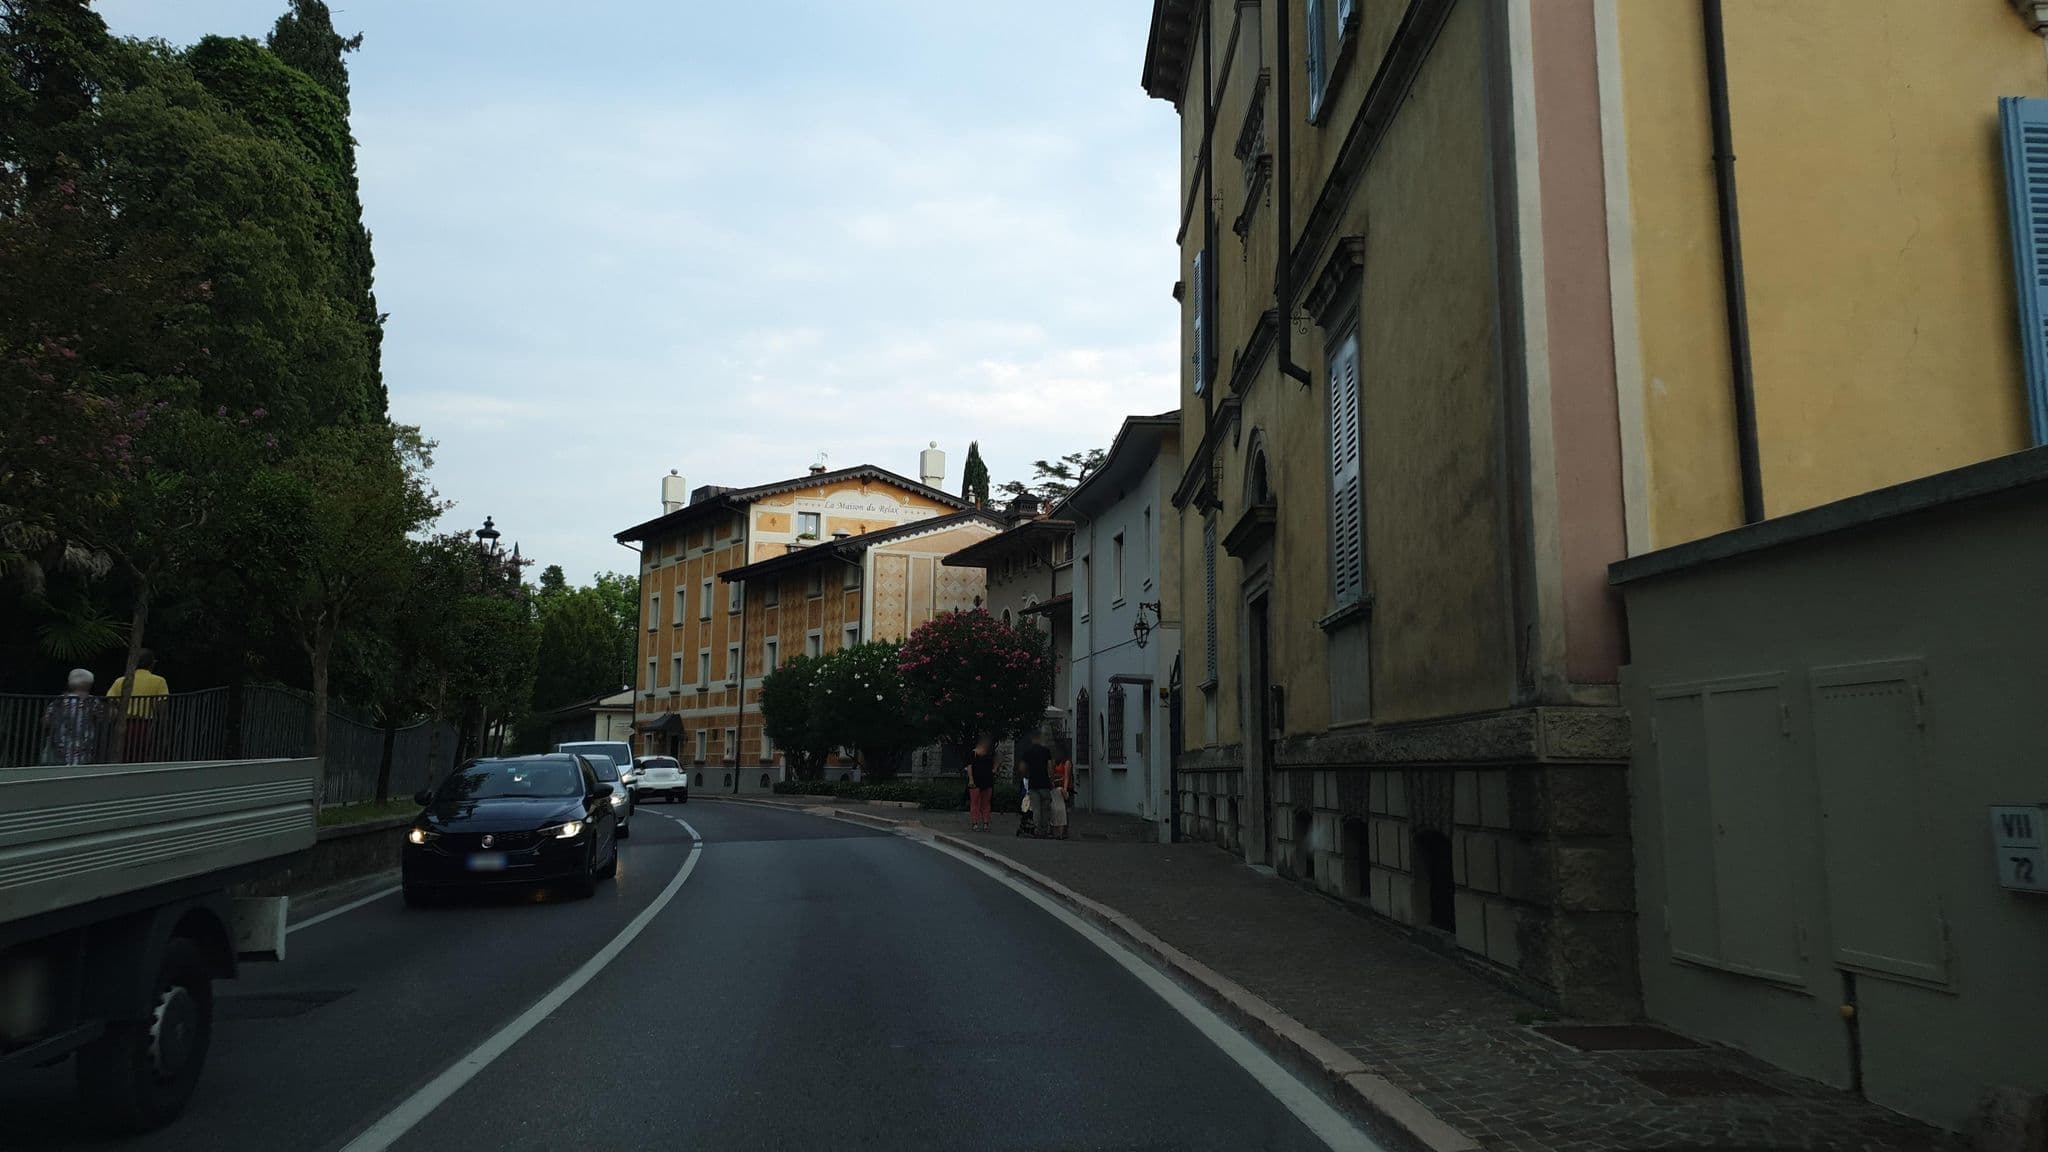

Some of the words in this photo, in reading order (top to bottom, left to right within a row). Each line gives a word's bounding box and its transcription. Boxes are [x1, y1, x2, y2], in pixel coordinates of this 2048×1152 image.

[824, 501, 835, 509] La
[836, 502, 863, 511] Maison
[878, 505, 900, 515] Relax
[2000, 814, 2032, 838] VII
[2009, 856, 2036, 883] 72
